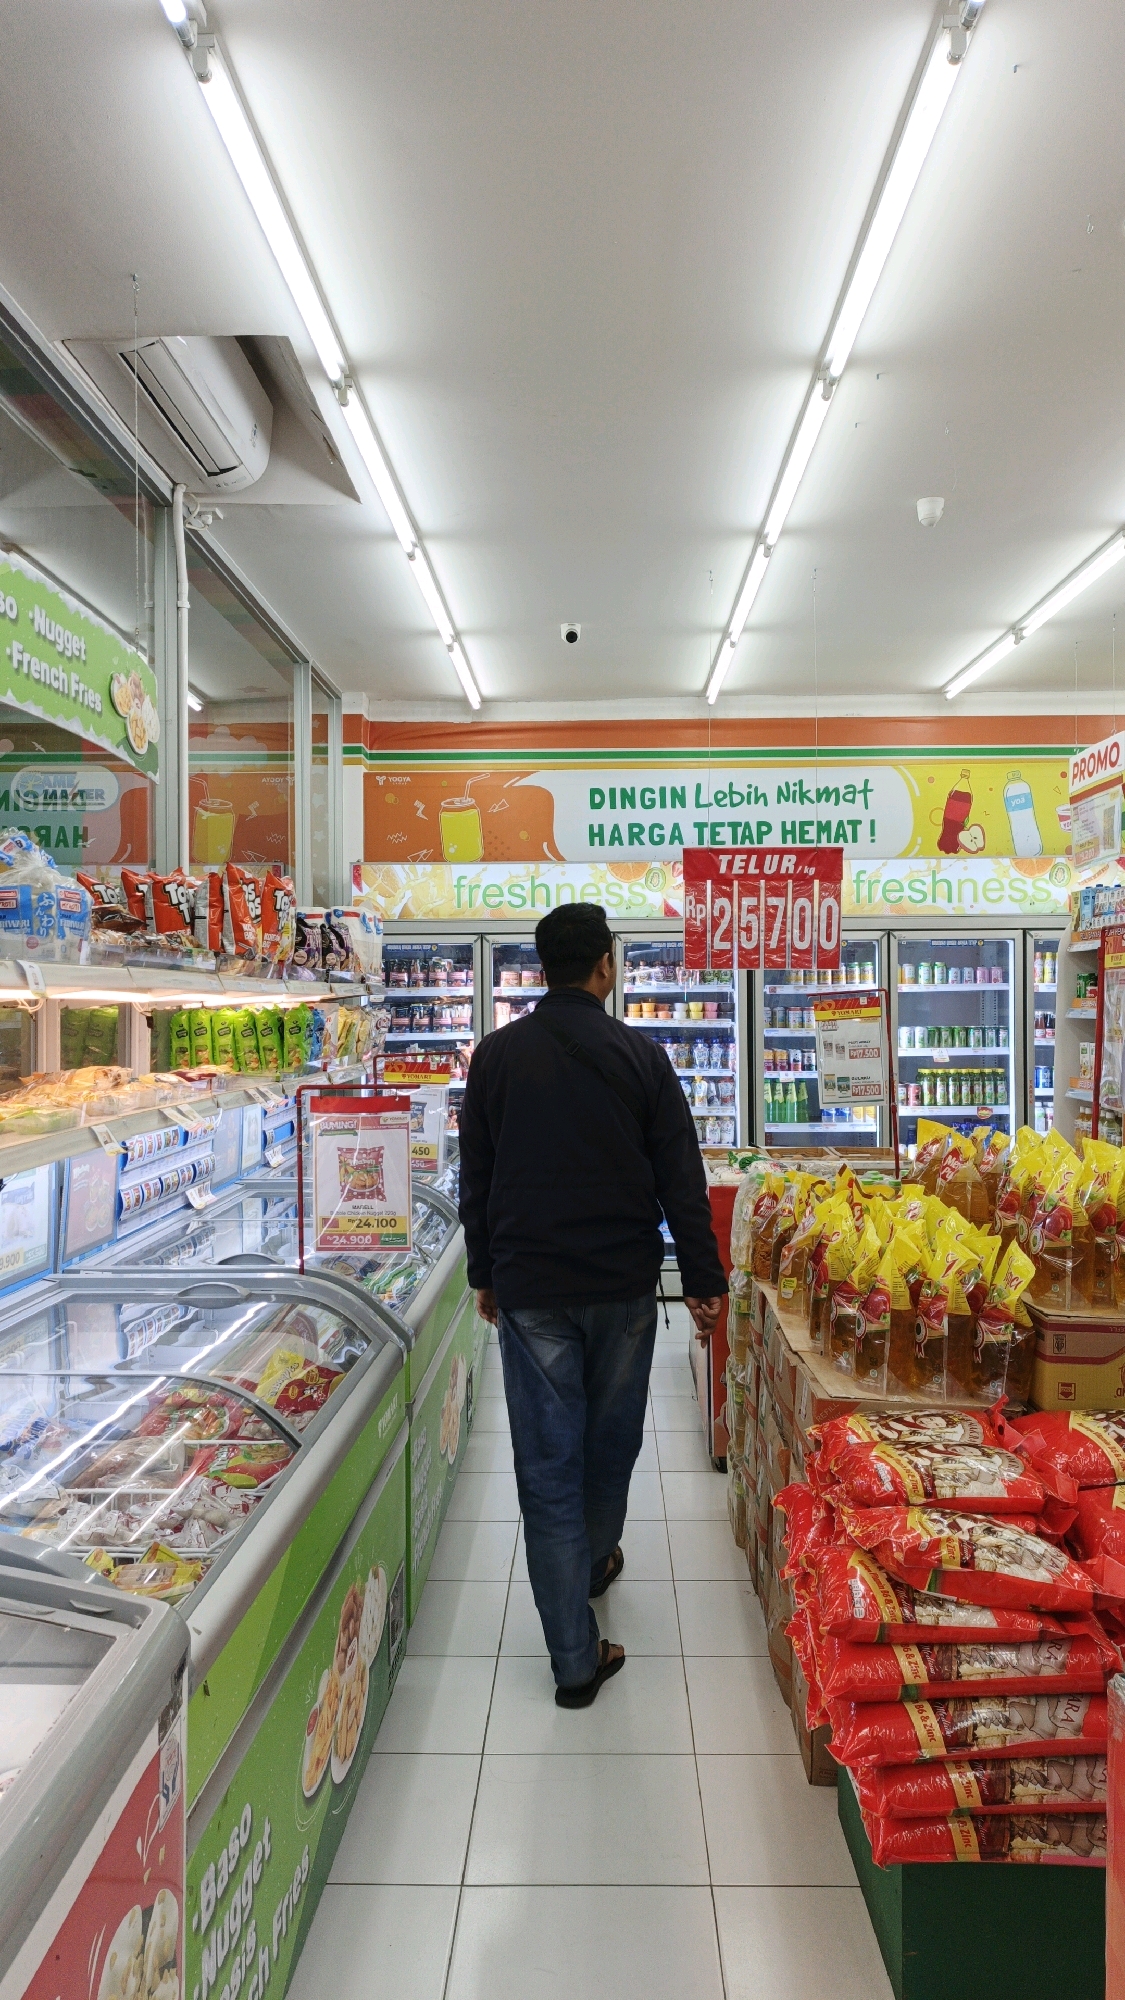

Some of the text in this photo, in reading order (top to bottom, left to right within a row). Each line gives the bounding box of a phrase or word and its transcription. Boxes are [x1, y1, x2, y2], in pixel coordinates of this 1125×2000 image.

[34, 604, 86, 661] Nugget
[12, 640, 102, 712] French Fries
[1072, 741, 1120, 787] PROMO
[589, 778, 875, 810] DINGIN Lebih Nikmat
[588, 822, 685, 847] HARGA
[693, 820, 773, 847] TETAP
[781, 819, 863, 845] HEMAT
[718, 854, 797, 875] TELUR
[454, 875, 647, 909] freshness
[853, 869, 1054, 905] freshness
[36, 892, 55, 938] ふんわり
[685, 895, 707, 926] Rp
[815, 1402, 840, 1422] REFILL
[907, 1660, 922, 1680] Zinc
[915, 1704, 925, 1716] B6
[922, 1722, 937, 1743] Zinc
[959, 1828, 972, 1848] Zinc
[200, 1802, 252, 1935] Baso
[201, 1815, 271, 2000] Nugget
[272, 1844, 309, 1962] Fries
